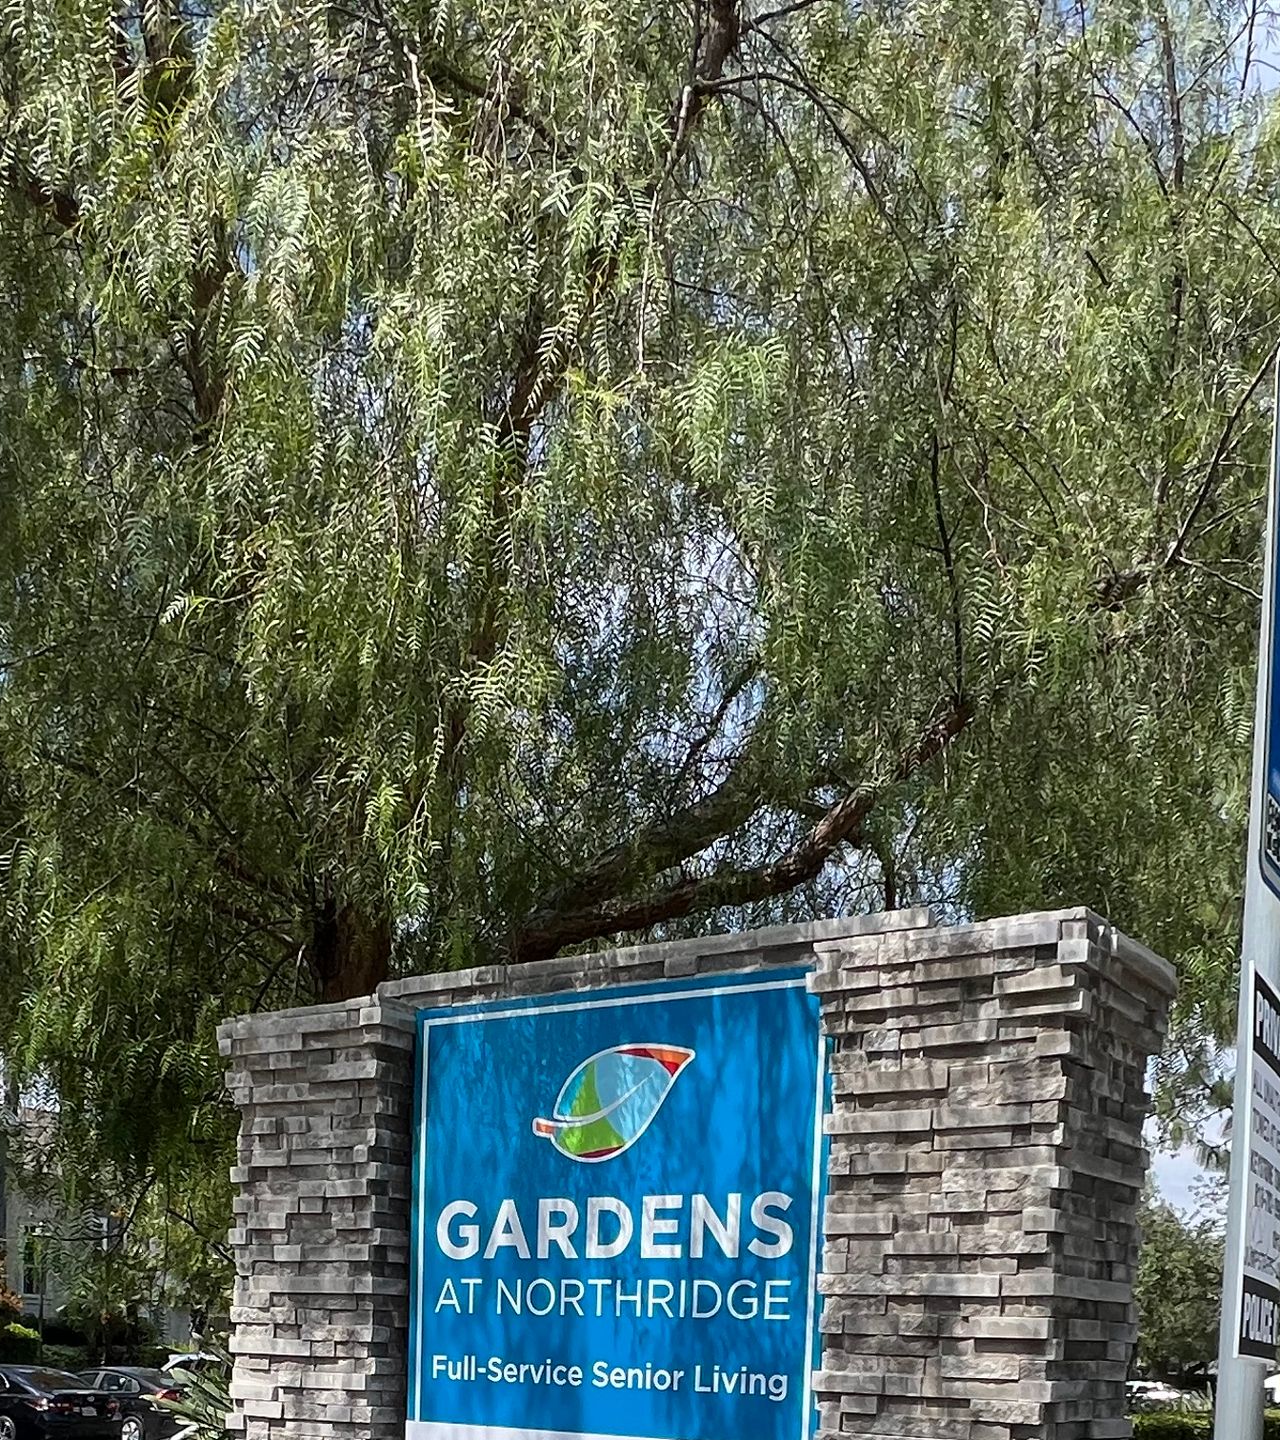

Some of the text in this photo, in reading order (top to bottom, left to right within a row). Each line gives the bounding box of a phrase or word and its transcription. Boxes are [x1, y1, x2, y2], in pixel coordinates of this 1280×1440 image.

[436, 1192, 795, 1260] GARDENS
[434, 1278, 792, 1321] AT NORTHRIDGE
[431, 1355, 789, 1402] Full-Service Senior Living
